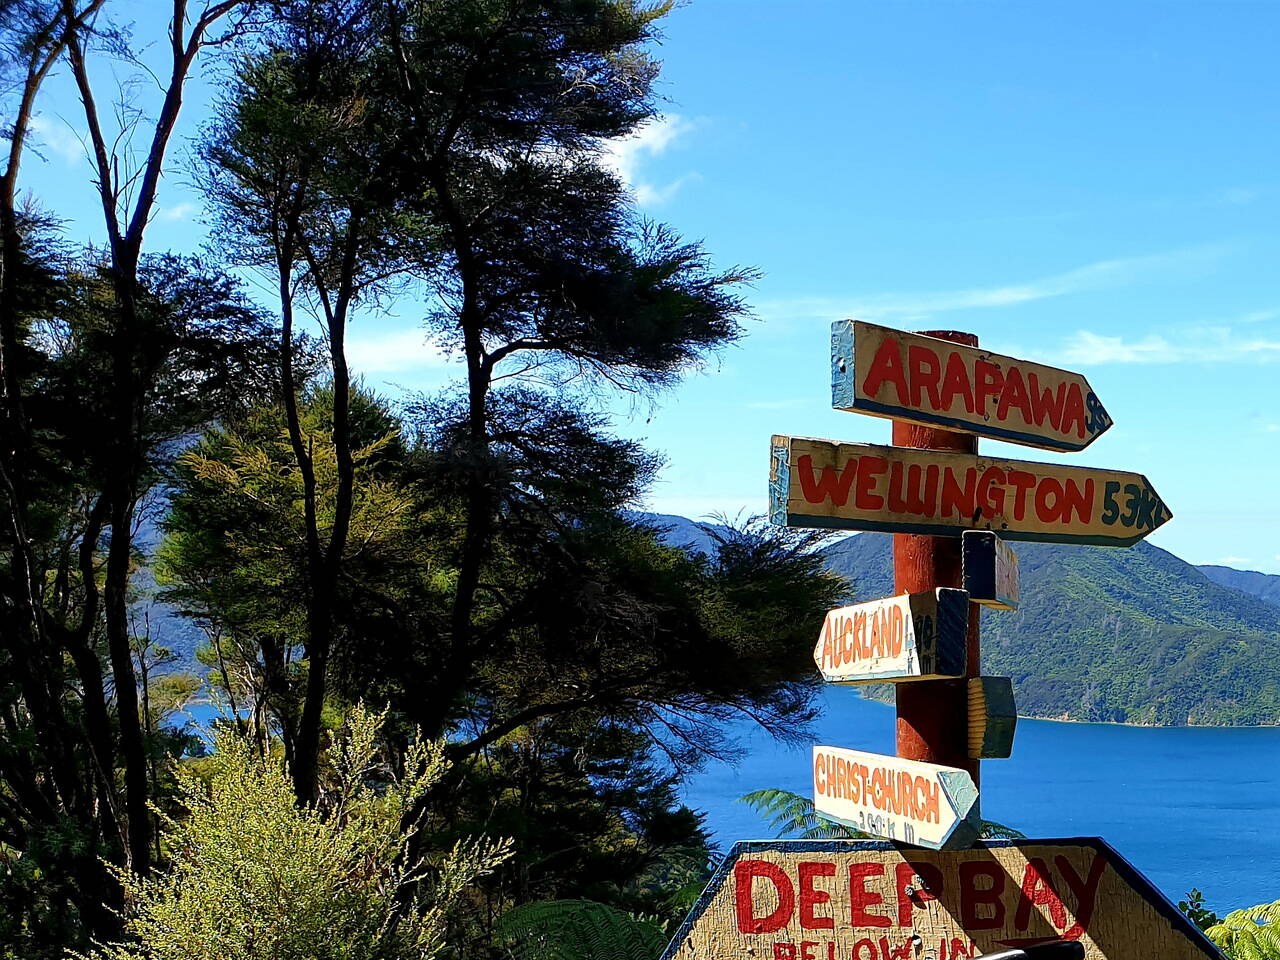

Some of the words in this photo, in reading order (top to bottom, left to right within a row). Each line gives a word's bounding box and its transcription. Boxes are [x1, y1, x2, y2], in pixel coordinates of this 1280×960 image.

[862, 338, 1086, 440] ARAPAWA
[797, 454, 1094, 525] WELLINGTON
[821, 604, 903, 670] AUCKLAND
[734, 860, 944, 934] DEEP
[958, 854, 1109, 940] BAY
